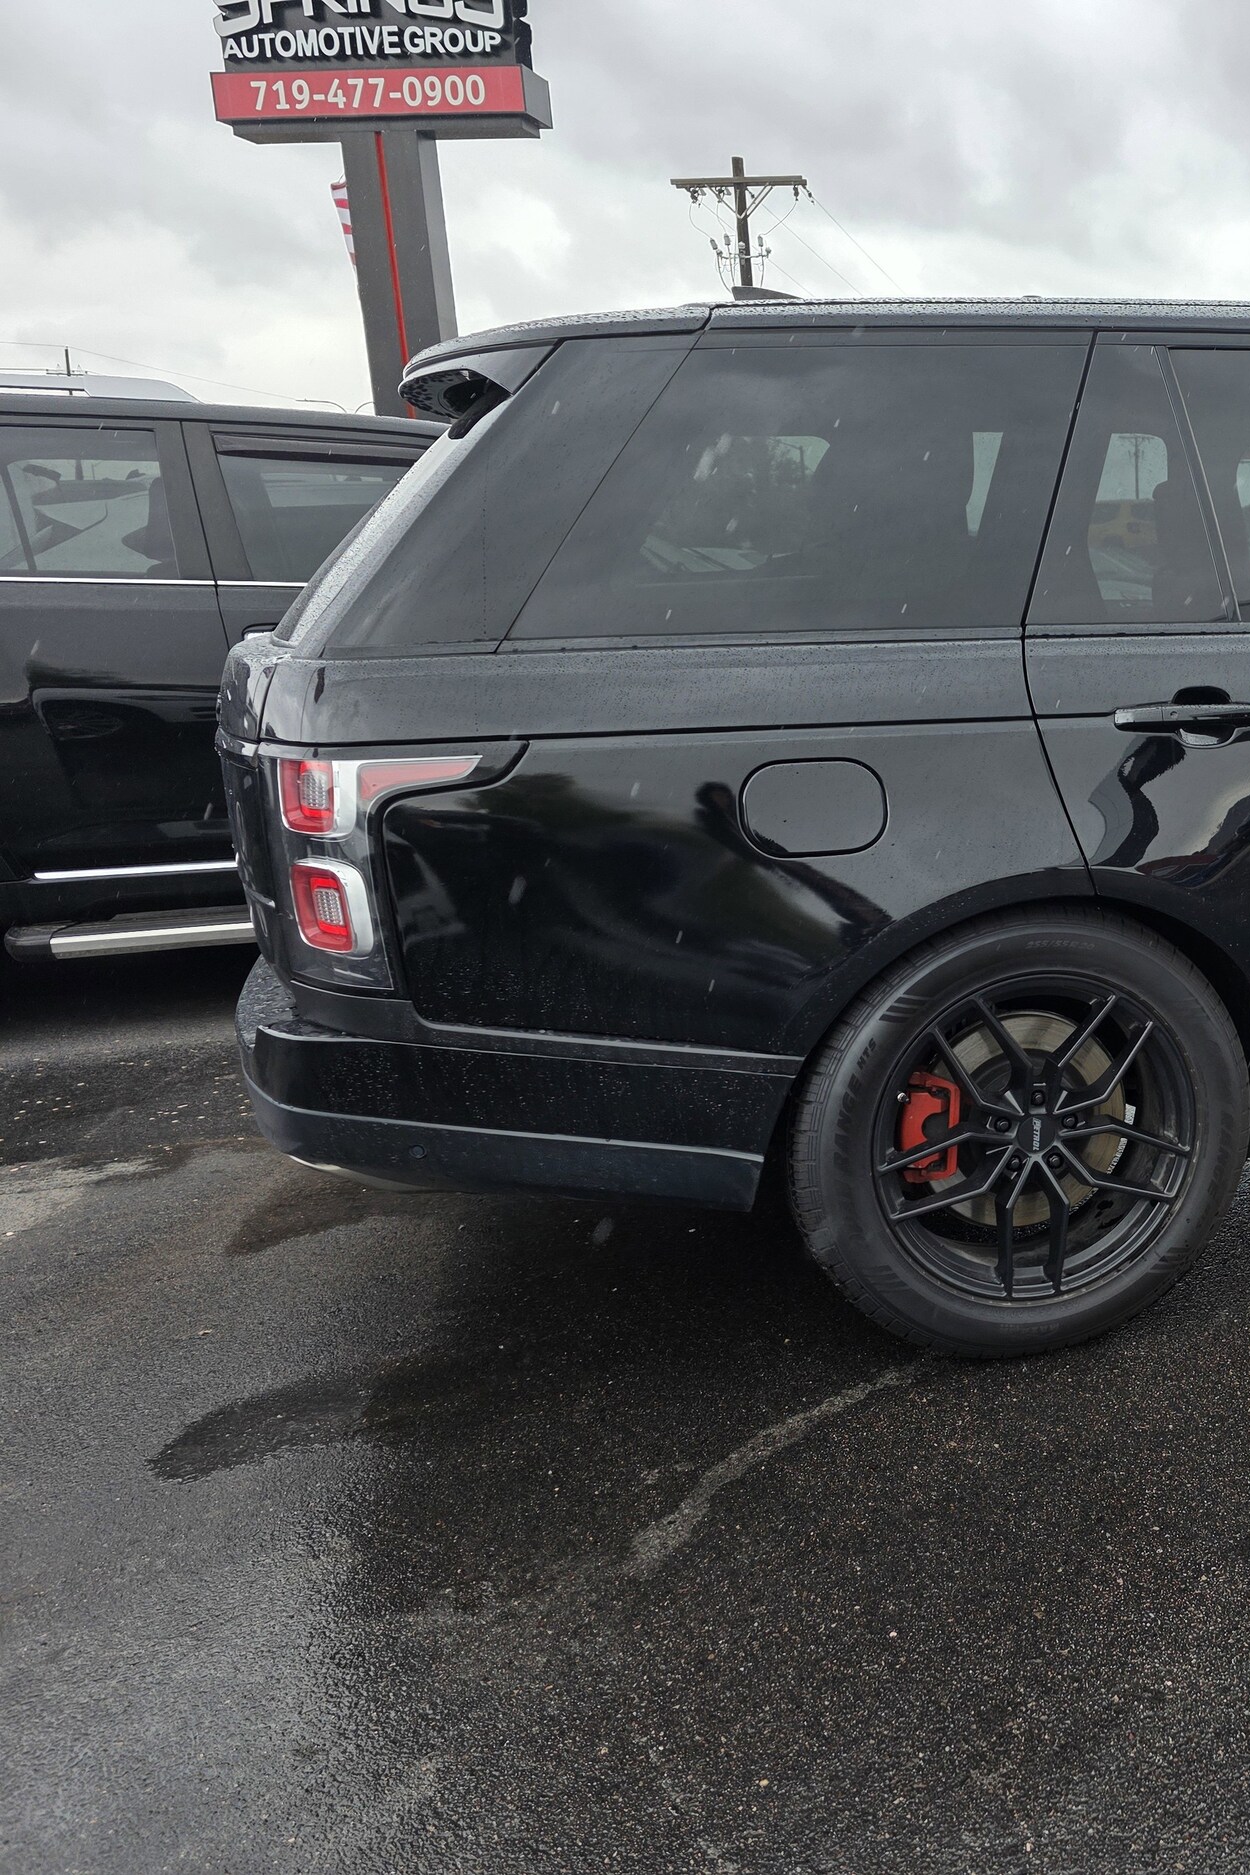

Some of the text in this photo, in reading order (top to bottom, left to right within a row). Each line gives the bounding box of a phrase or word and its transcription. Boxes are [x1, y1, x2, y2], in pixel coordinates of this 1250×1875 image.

[224, 25, 501, 58] AUTOMOTIVE GROUP
[250, 75, 486, 110] 719-477-0900
[856, 1037, 877, 1070] HTS
